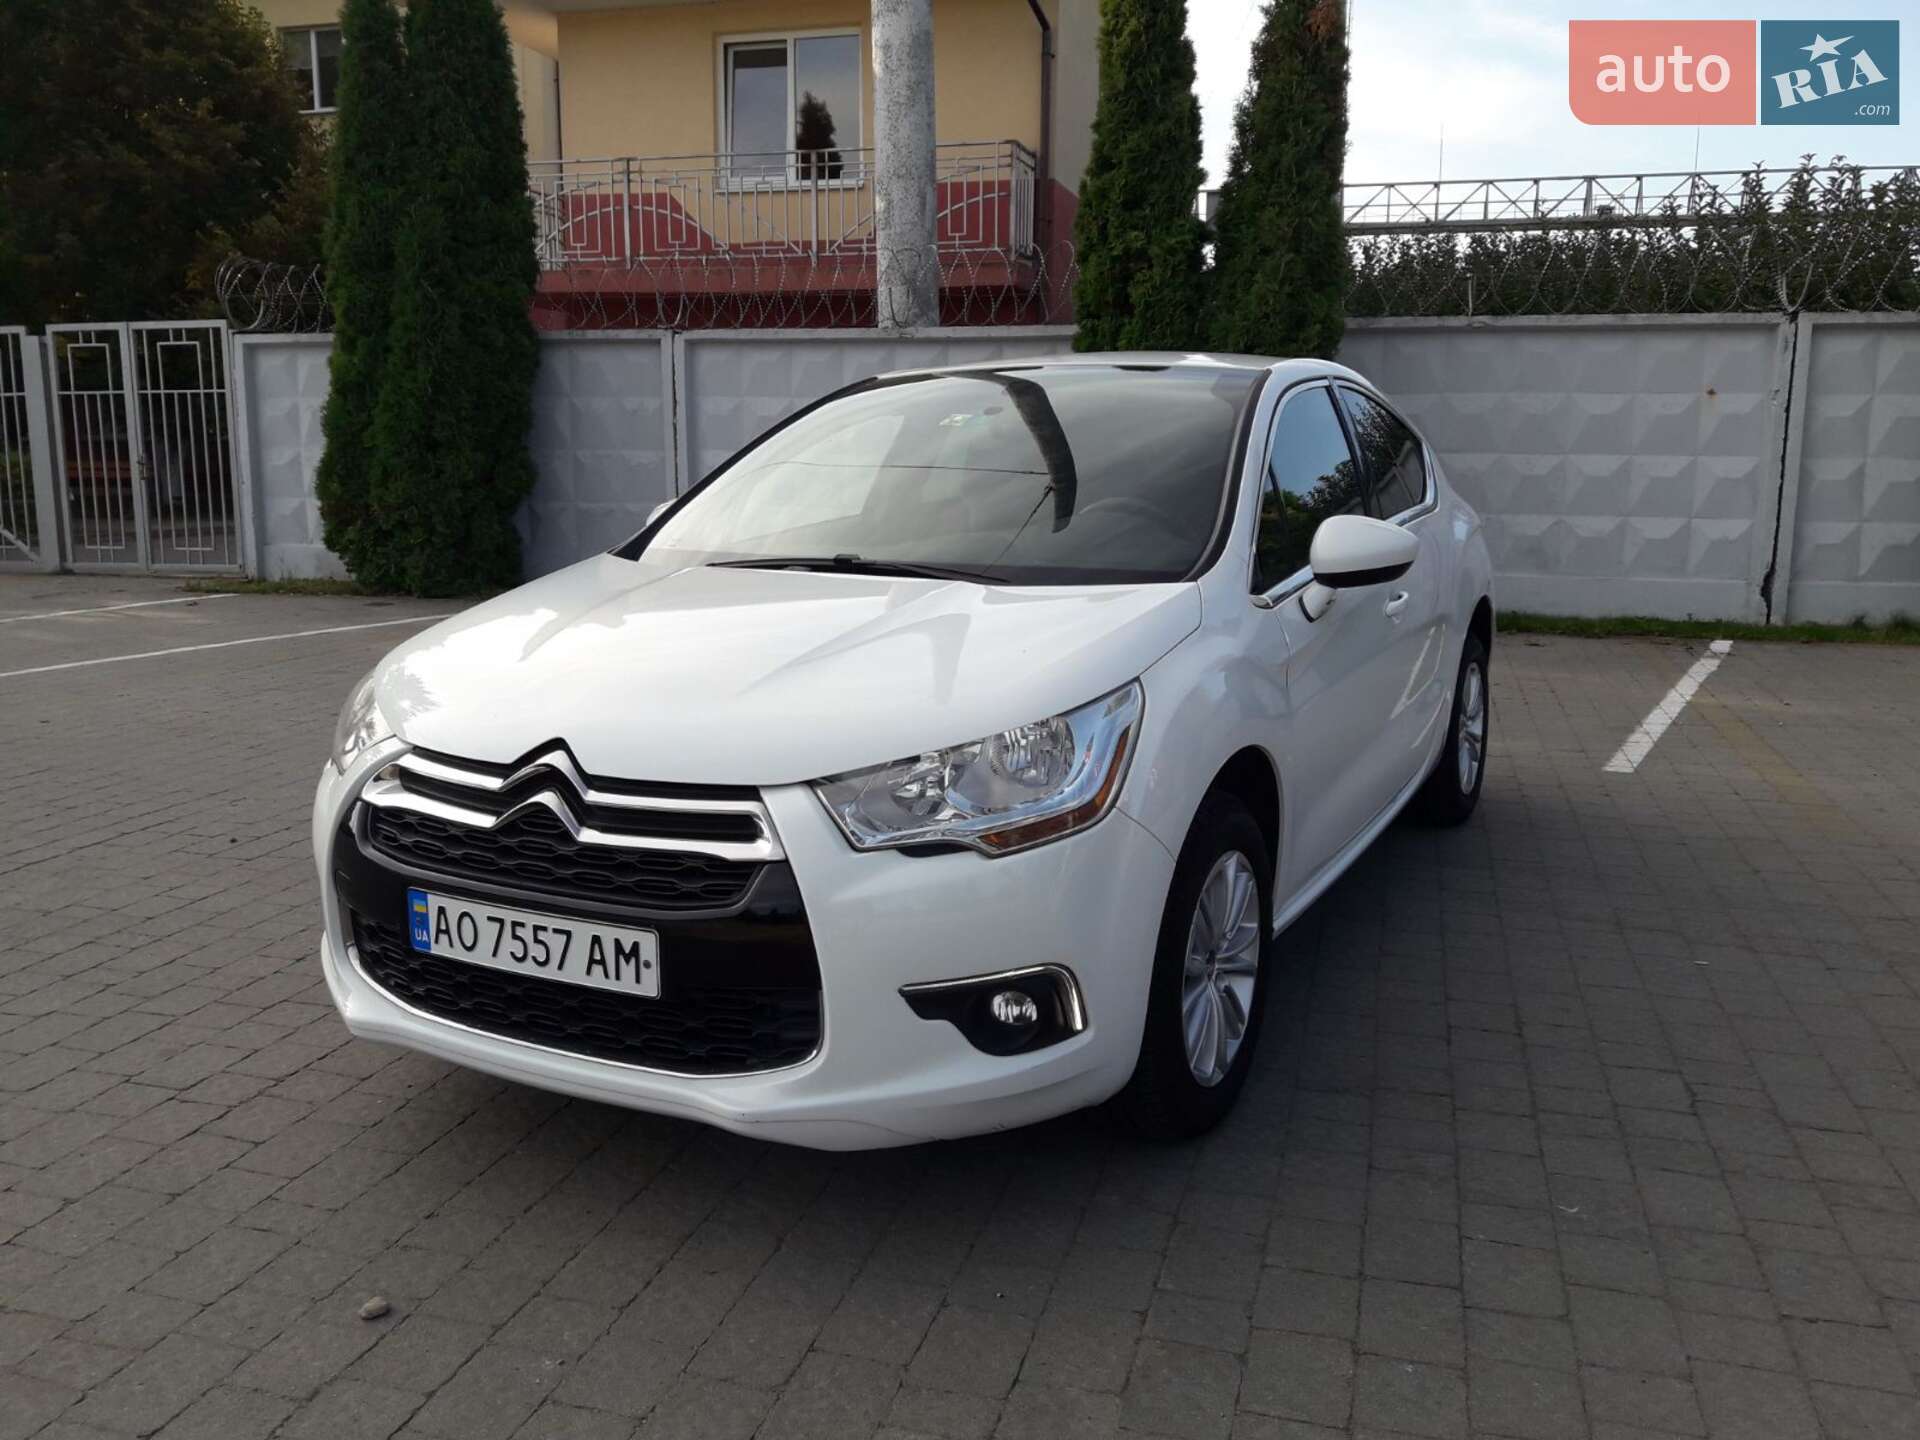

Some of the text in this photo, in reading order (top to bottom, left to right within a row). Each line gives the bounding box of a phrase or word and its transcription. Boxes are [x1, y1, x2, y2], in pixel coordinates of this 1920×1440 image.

[414, 928, 430, 942] UA
[434, 905, 641, 984] AO 7557 AM
